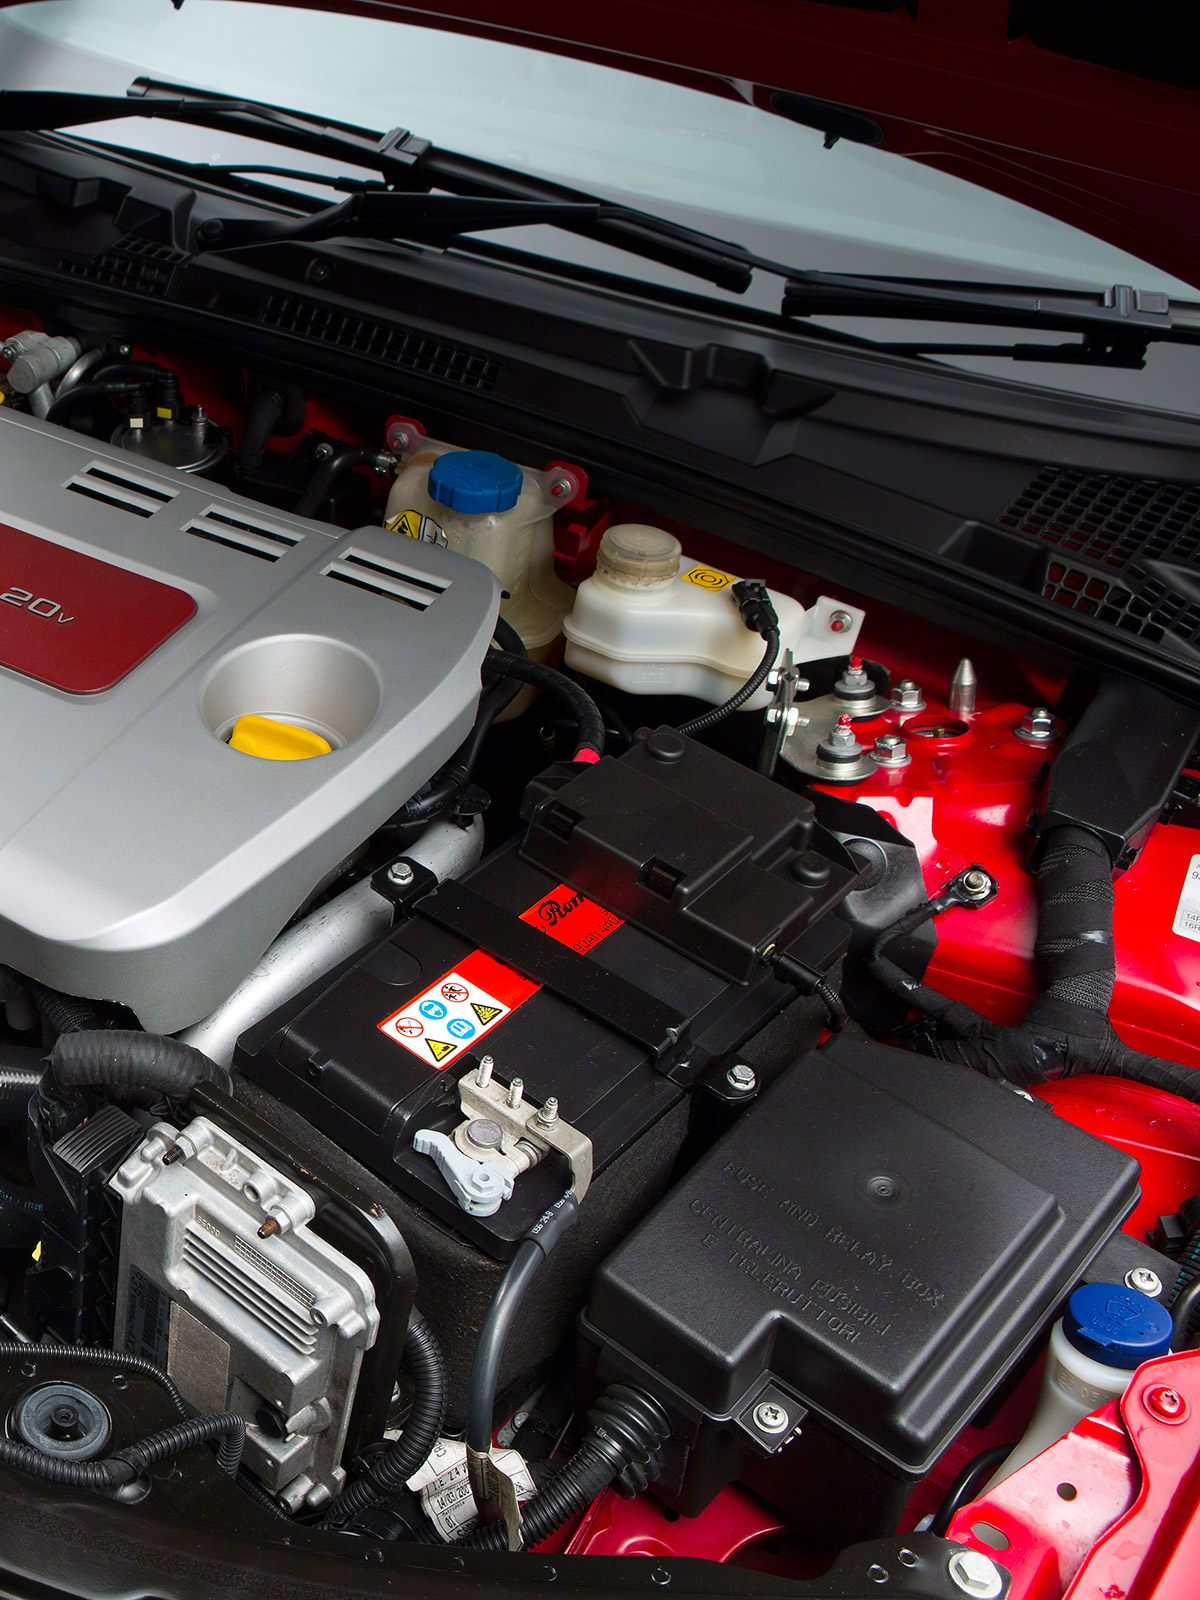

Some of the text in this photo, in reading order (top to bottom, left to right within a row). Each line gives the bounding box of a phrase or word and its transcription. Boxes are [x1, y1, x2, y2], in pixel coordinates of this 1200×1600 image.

[689, 1198, 892, 1336] CENTRALINA FUSIBILI
[702, 1233, 861, 1343] E TELERUTTORI
[722, 1161, 945, 1308] FUSE AND RELAY BOX
